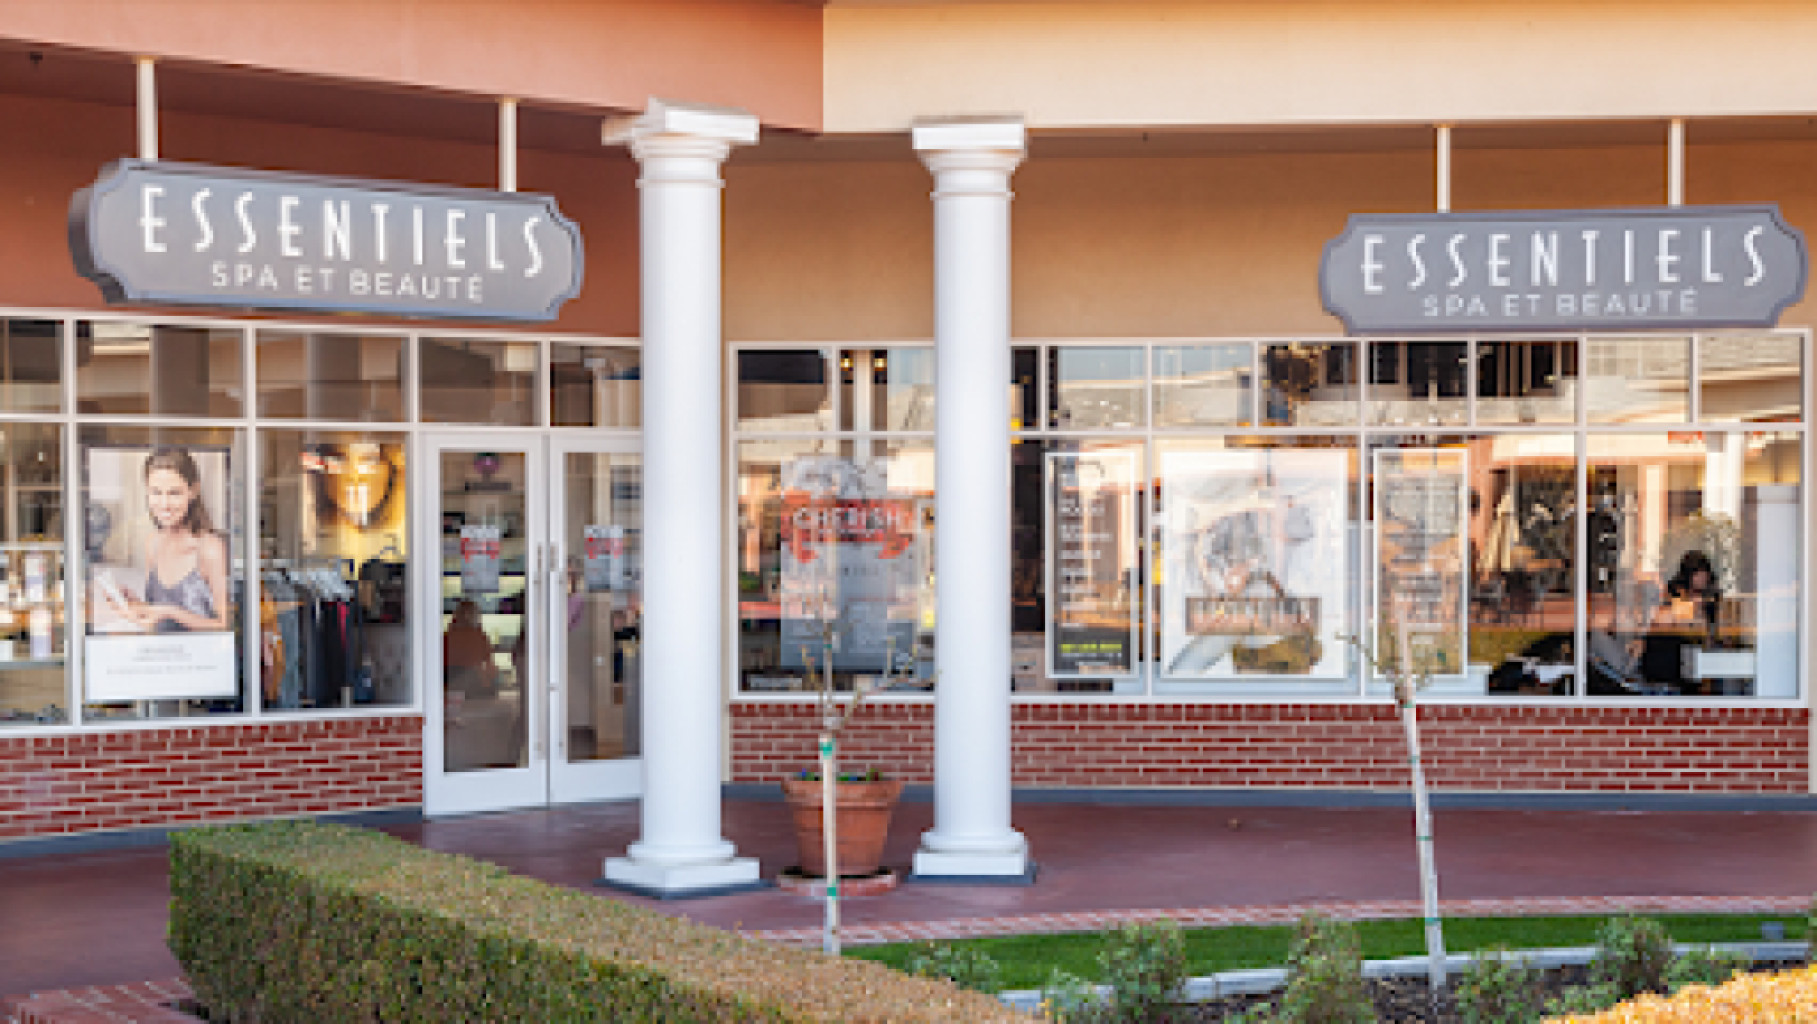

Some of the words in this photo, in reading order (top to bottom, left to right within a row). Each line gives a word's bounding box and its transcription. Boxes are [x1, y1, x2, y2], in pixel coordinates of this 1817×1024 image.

[139, 183, 543, 278] ESSENTIELS
[211, 261, 278, 291] SPA
[297, 264, 335, 293] ET
[349, 267, 484, 302] BEAUTÉ
[1360, 225, 1767, 294] ESSENTIELS
[1421, 294, 1489, 318] SPA
[1504, 293, 1542, 318] ET
[1556, 286, 1699, 317] BEAUTÉ
